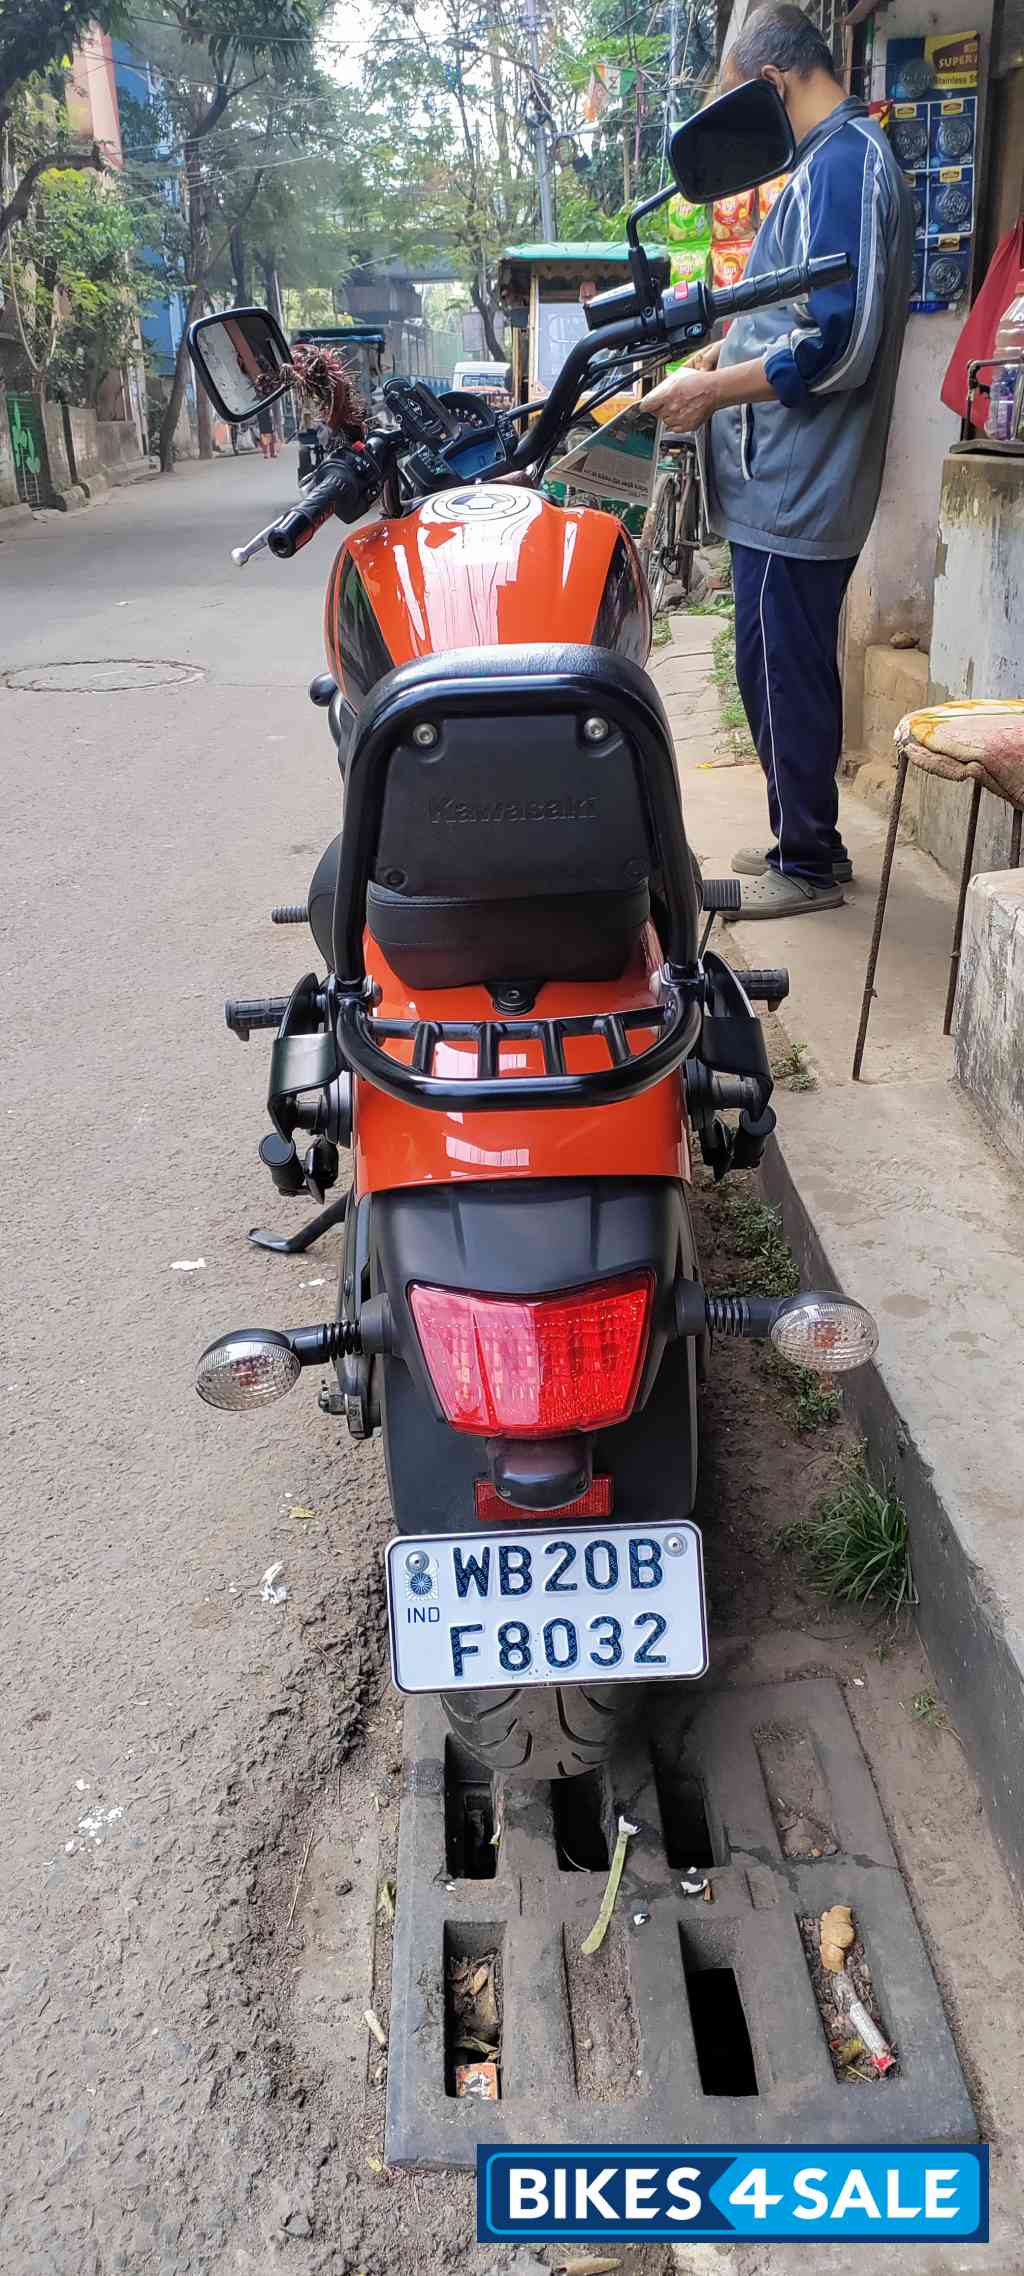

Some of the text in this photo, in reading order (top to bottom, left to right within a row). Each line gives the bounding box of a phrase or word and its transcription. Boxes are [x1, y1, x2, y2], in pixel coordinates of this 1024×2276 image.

[427, 792, 599, 824] Kawasaki
[452, 1538, 664, 1598] WB20B
[407, 1606, 441, 1624] IND
[450, 1612, 668, 1677] F8032
